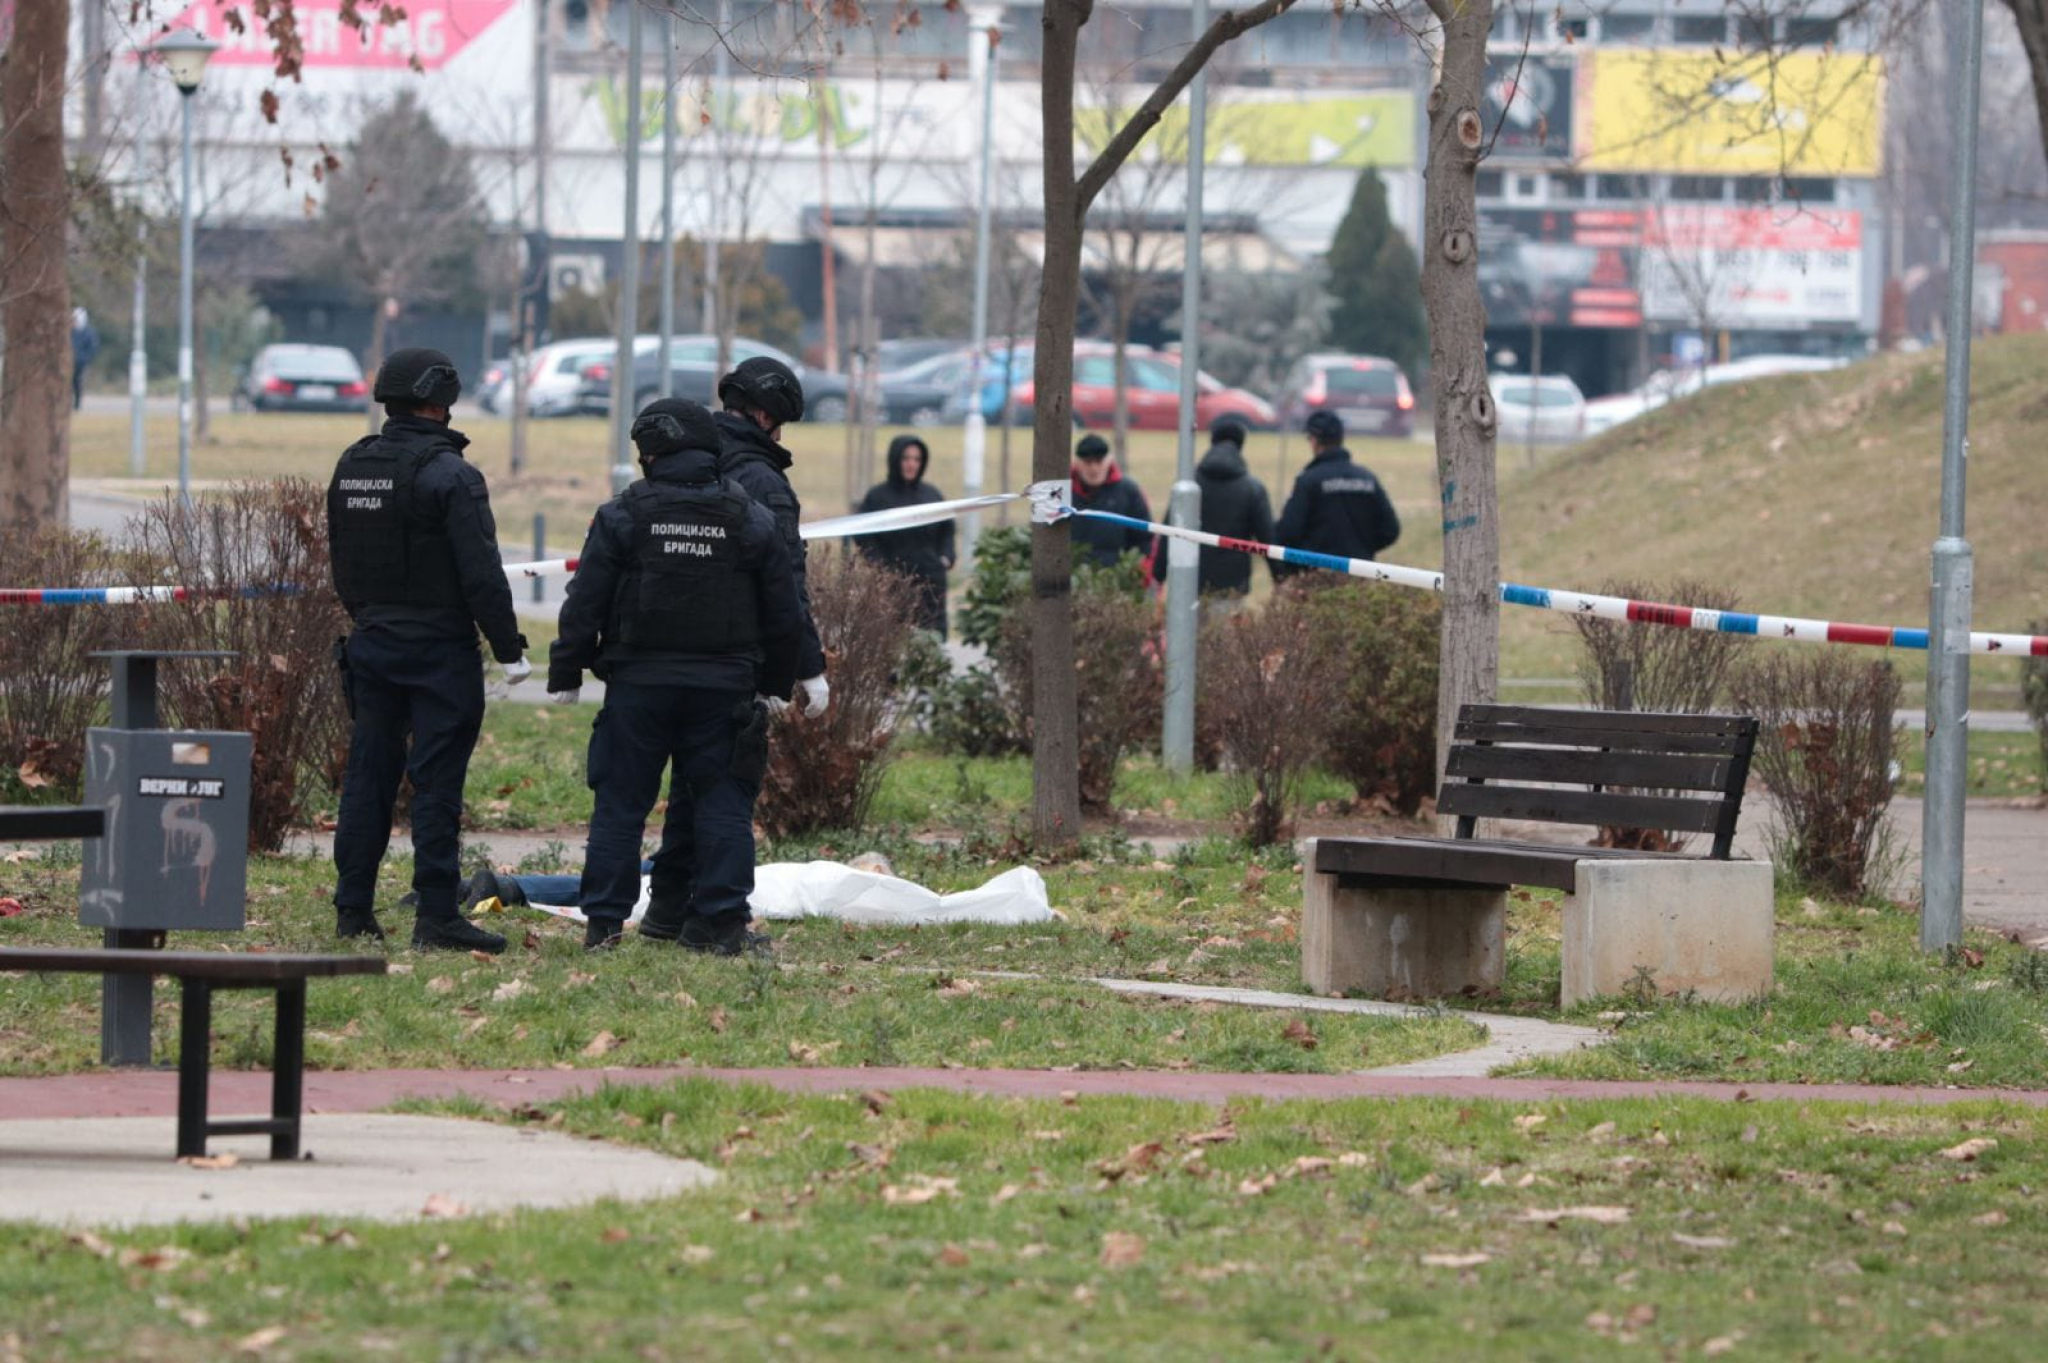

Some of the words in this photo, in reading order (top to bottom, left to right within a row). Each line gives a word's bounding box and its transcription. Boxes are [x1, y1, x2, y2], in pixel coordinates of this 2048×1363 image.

[340, 479, 393, 491] ПОЛИЦИЈСКА
[347, 497, 382, 510] БРИГАДА
[651, 524, 726, 539] ПОЛИЦИЈСКА
[664, 541, 712, 557] БРИГАДА
